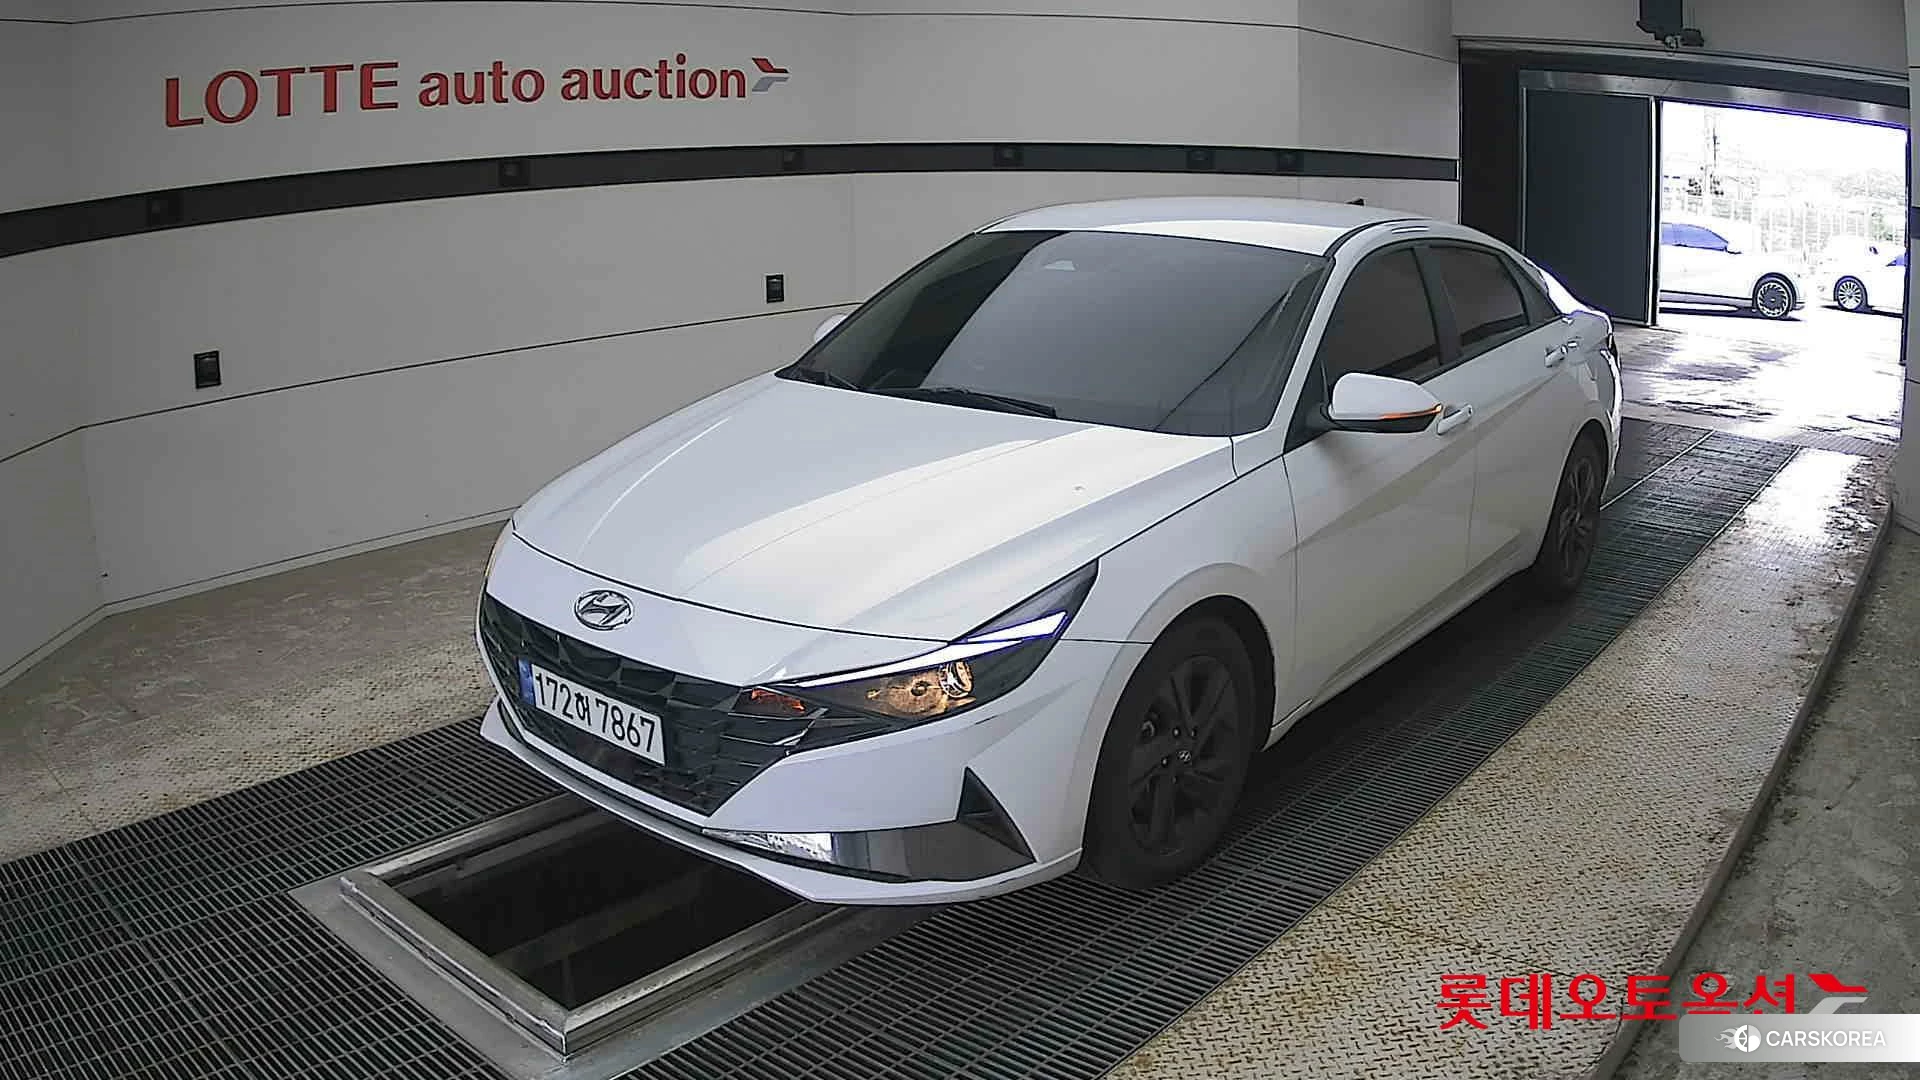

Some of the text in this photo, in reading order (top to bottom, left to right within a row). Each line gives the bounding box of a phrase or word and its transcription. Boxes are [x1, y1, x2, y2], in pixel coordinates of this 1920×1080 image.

[165, 53, 746, 127] LOTTE auto auction
[536, 672, 656, 753] 172허 7867
